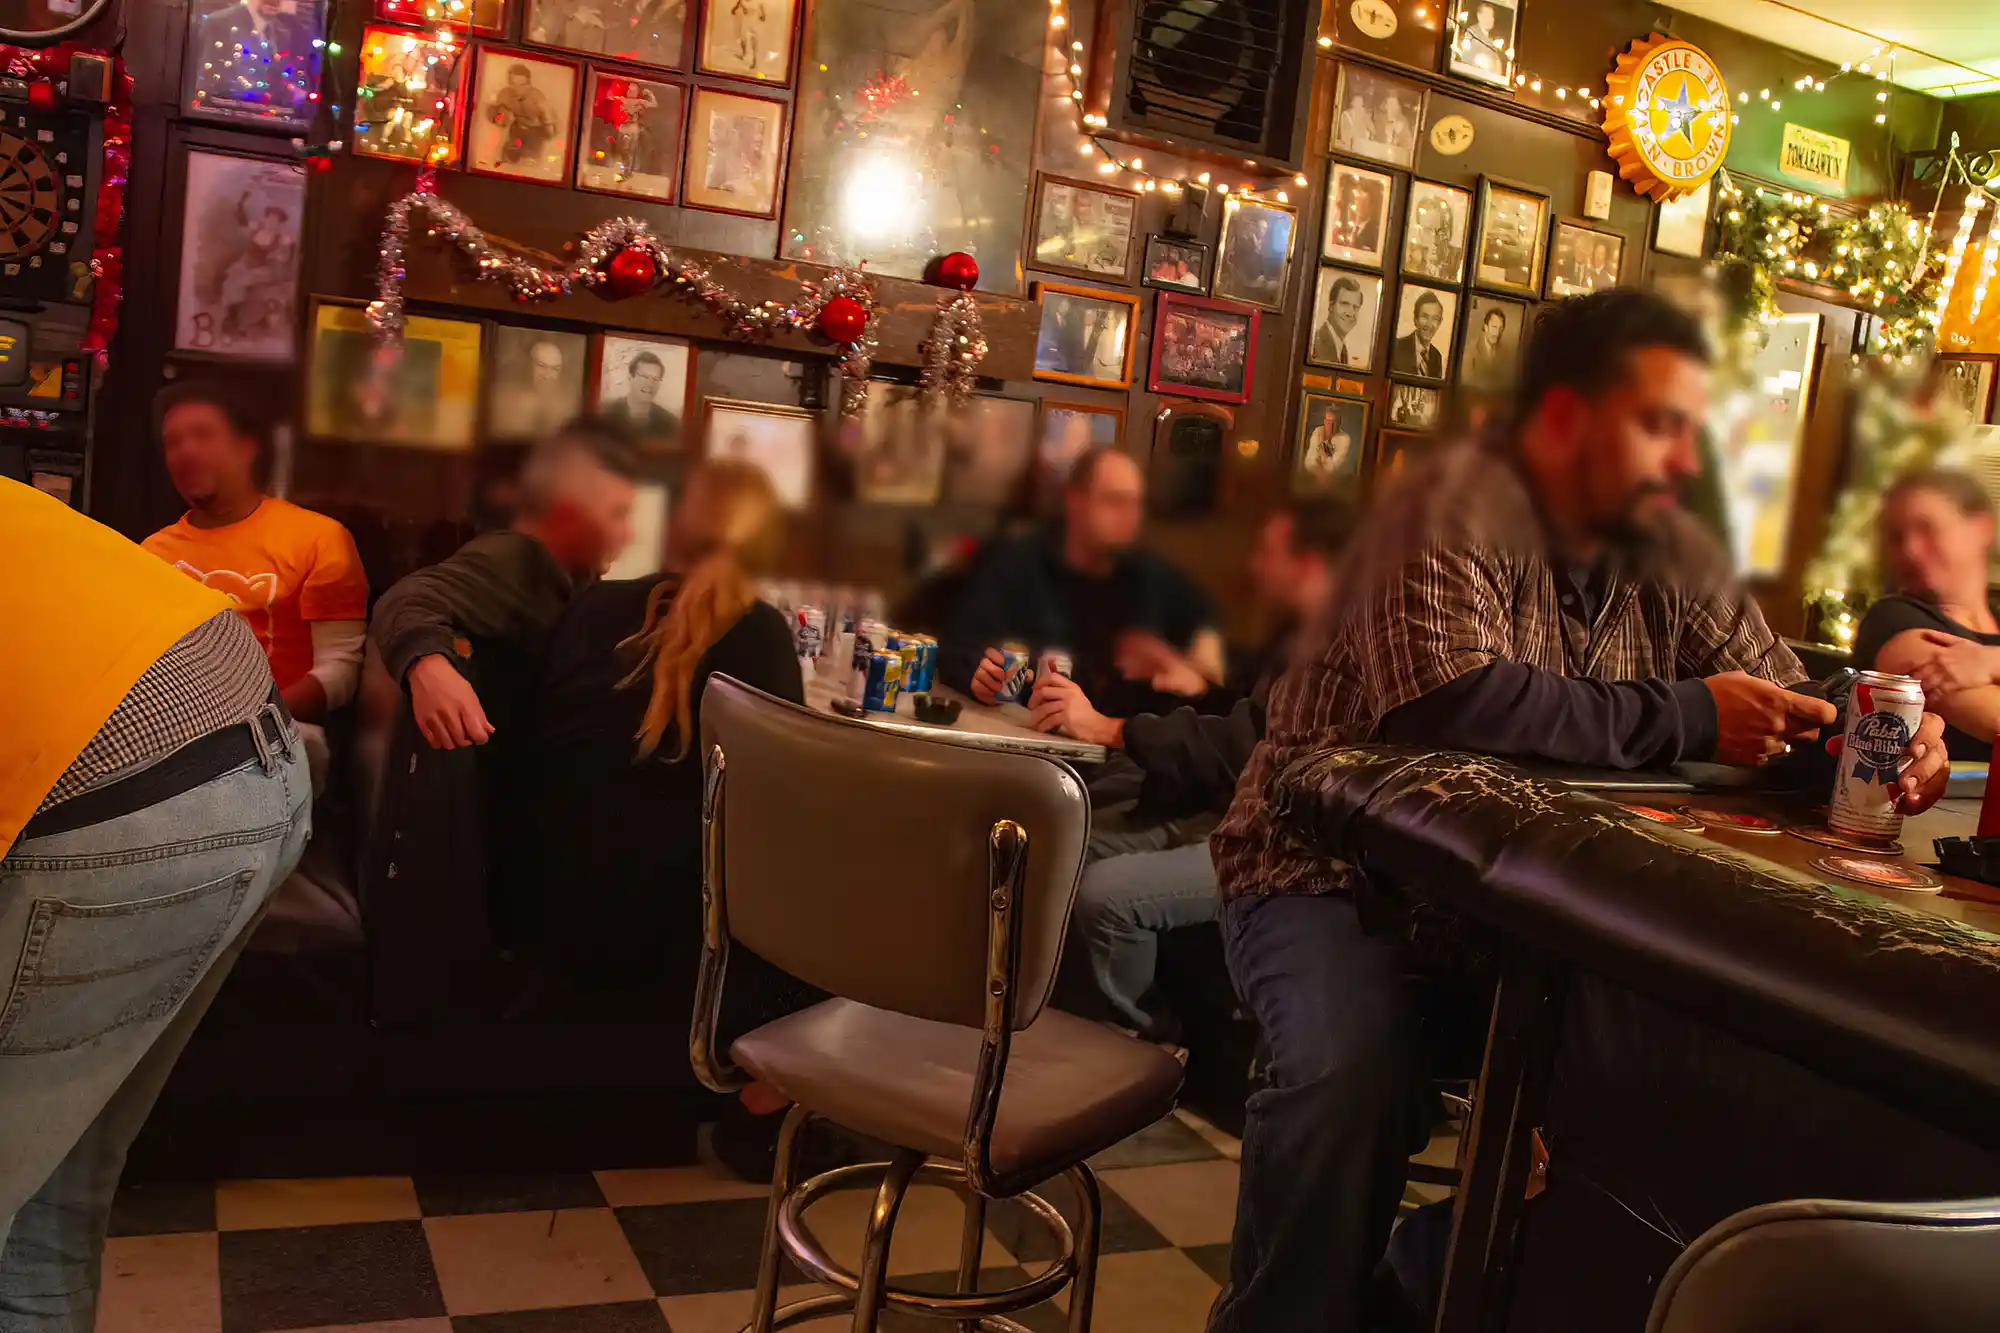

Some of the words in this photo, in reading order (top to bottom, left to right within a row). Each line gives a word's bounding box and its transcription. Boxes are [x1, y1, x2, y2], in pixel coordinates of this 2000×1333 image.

[1673, 123, 1725, 176] BROWN
[1864, 719, 1901, 739] Pabst
[1849, 733, 1873, 751] Blue
[1873, 738, 1901, 755] Ribb
